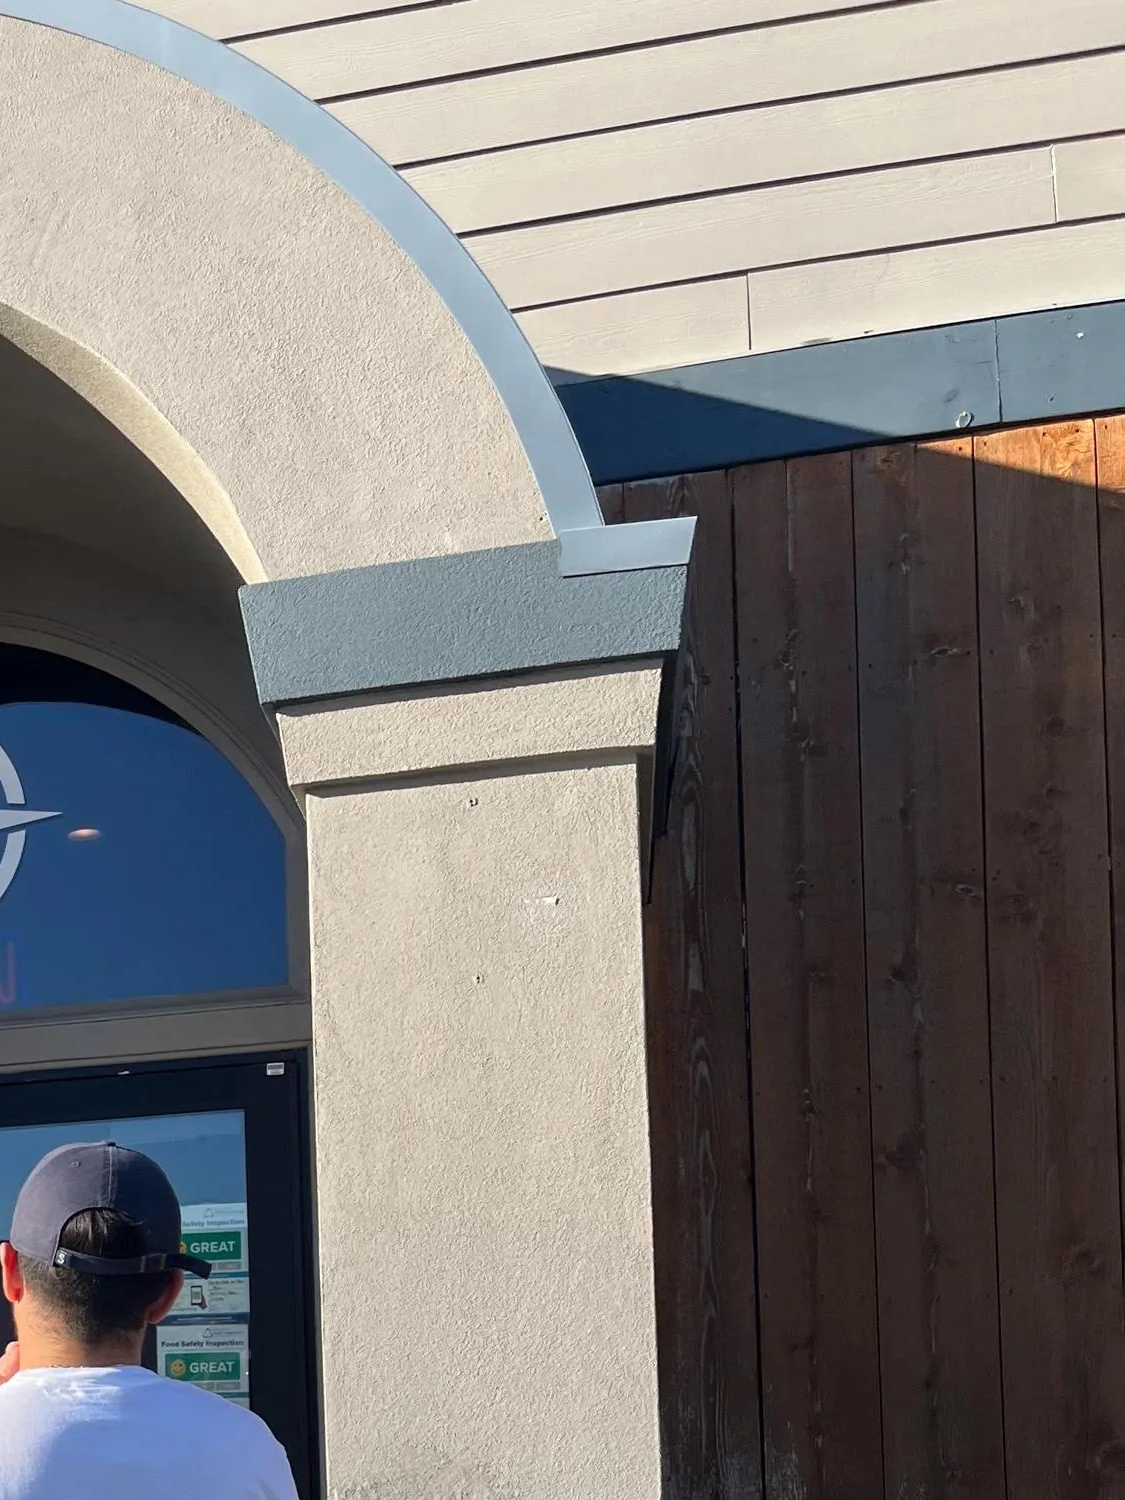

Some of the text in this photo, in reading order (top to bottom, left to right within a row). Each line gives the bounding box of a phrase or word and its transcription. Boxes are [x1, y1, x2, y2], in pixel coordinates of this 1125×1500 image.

[190, 1241, 236, 1254] GREAT
[181, 1340, 204, 1348] Safety
[205, 1339, 244, 1348] Inspection
[189, 1361, 236, 1374] GREAT
